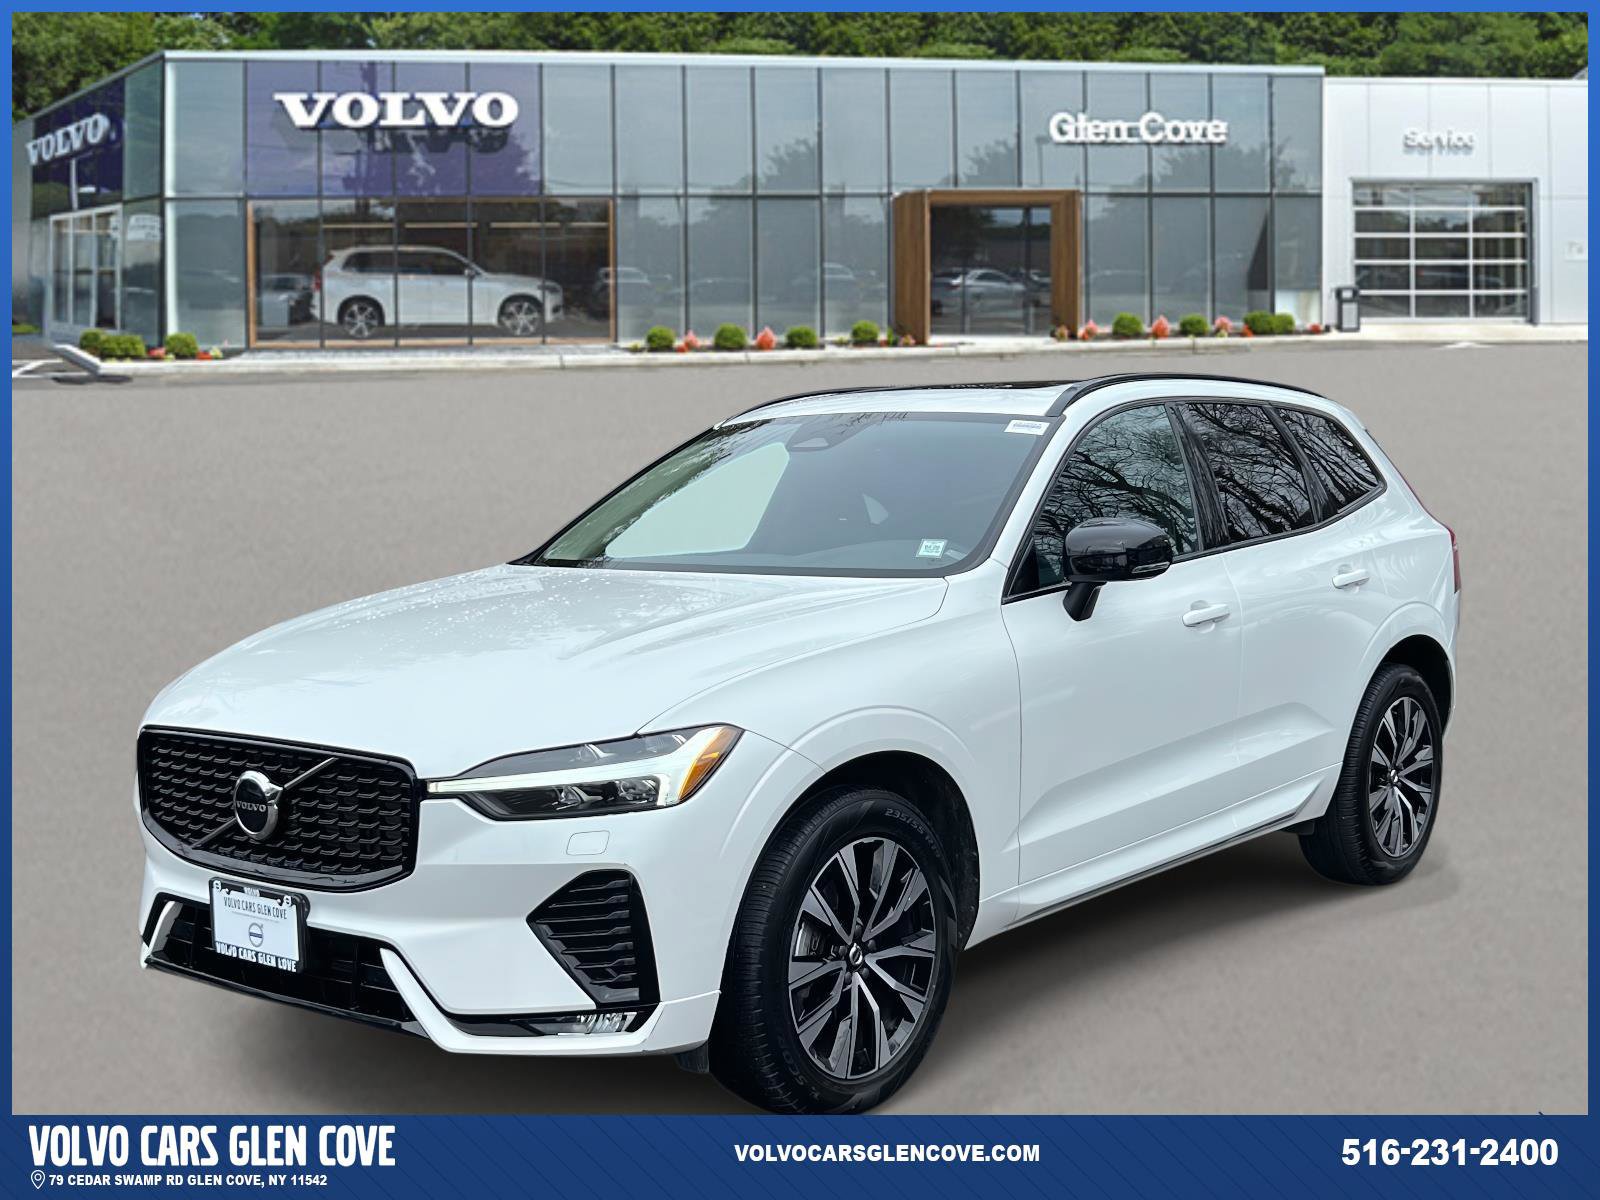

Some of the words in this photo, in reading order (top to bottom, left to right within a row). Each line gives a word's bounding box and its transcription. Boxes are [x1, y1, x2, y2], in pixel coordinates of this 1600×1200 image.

[273, 92, 519, 128] VOLVO
[25, 112, 110, 166] VOLVO
[1049, 112, 1130, 143] Glen
[1139, 112, 1229, 143] Cove
[1403, 128, 1475, 154] Service
[236, 800, 266, 812] VOLVO
[223, 896, 241, 910] VOLVO
[241, 899, 256, 913] CARS
[257, 903, 272, 917] GLEN
[273, 907, 288, 920] COVE
[215, 941, 237, 958] VOLVO
[238, 947, 257, 963] CARS
[258, 952, 277, 968] GLEN
